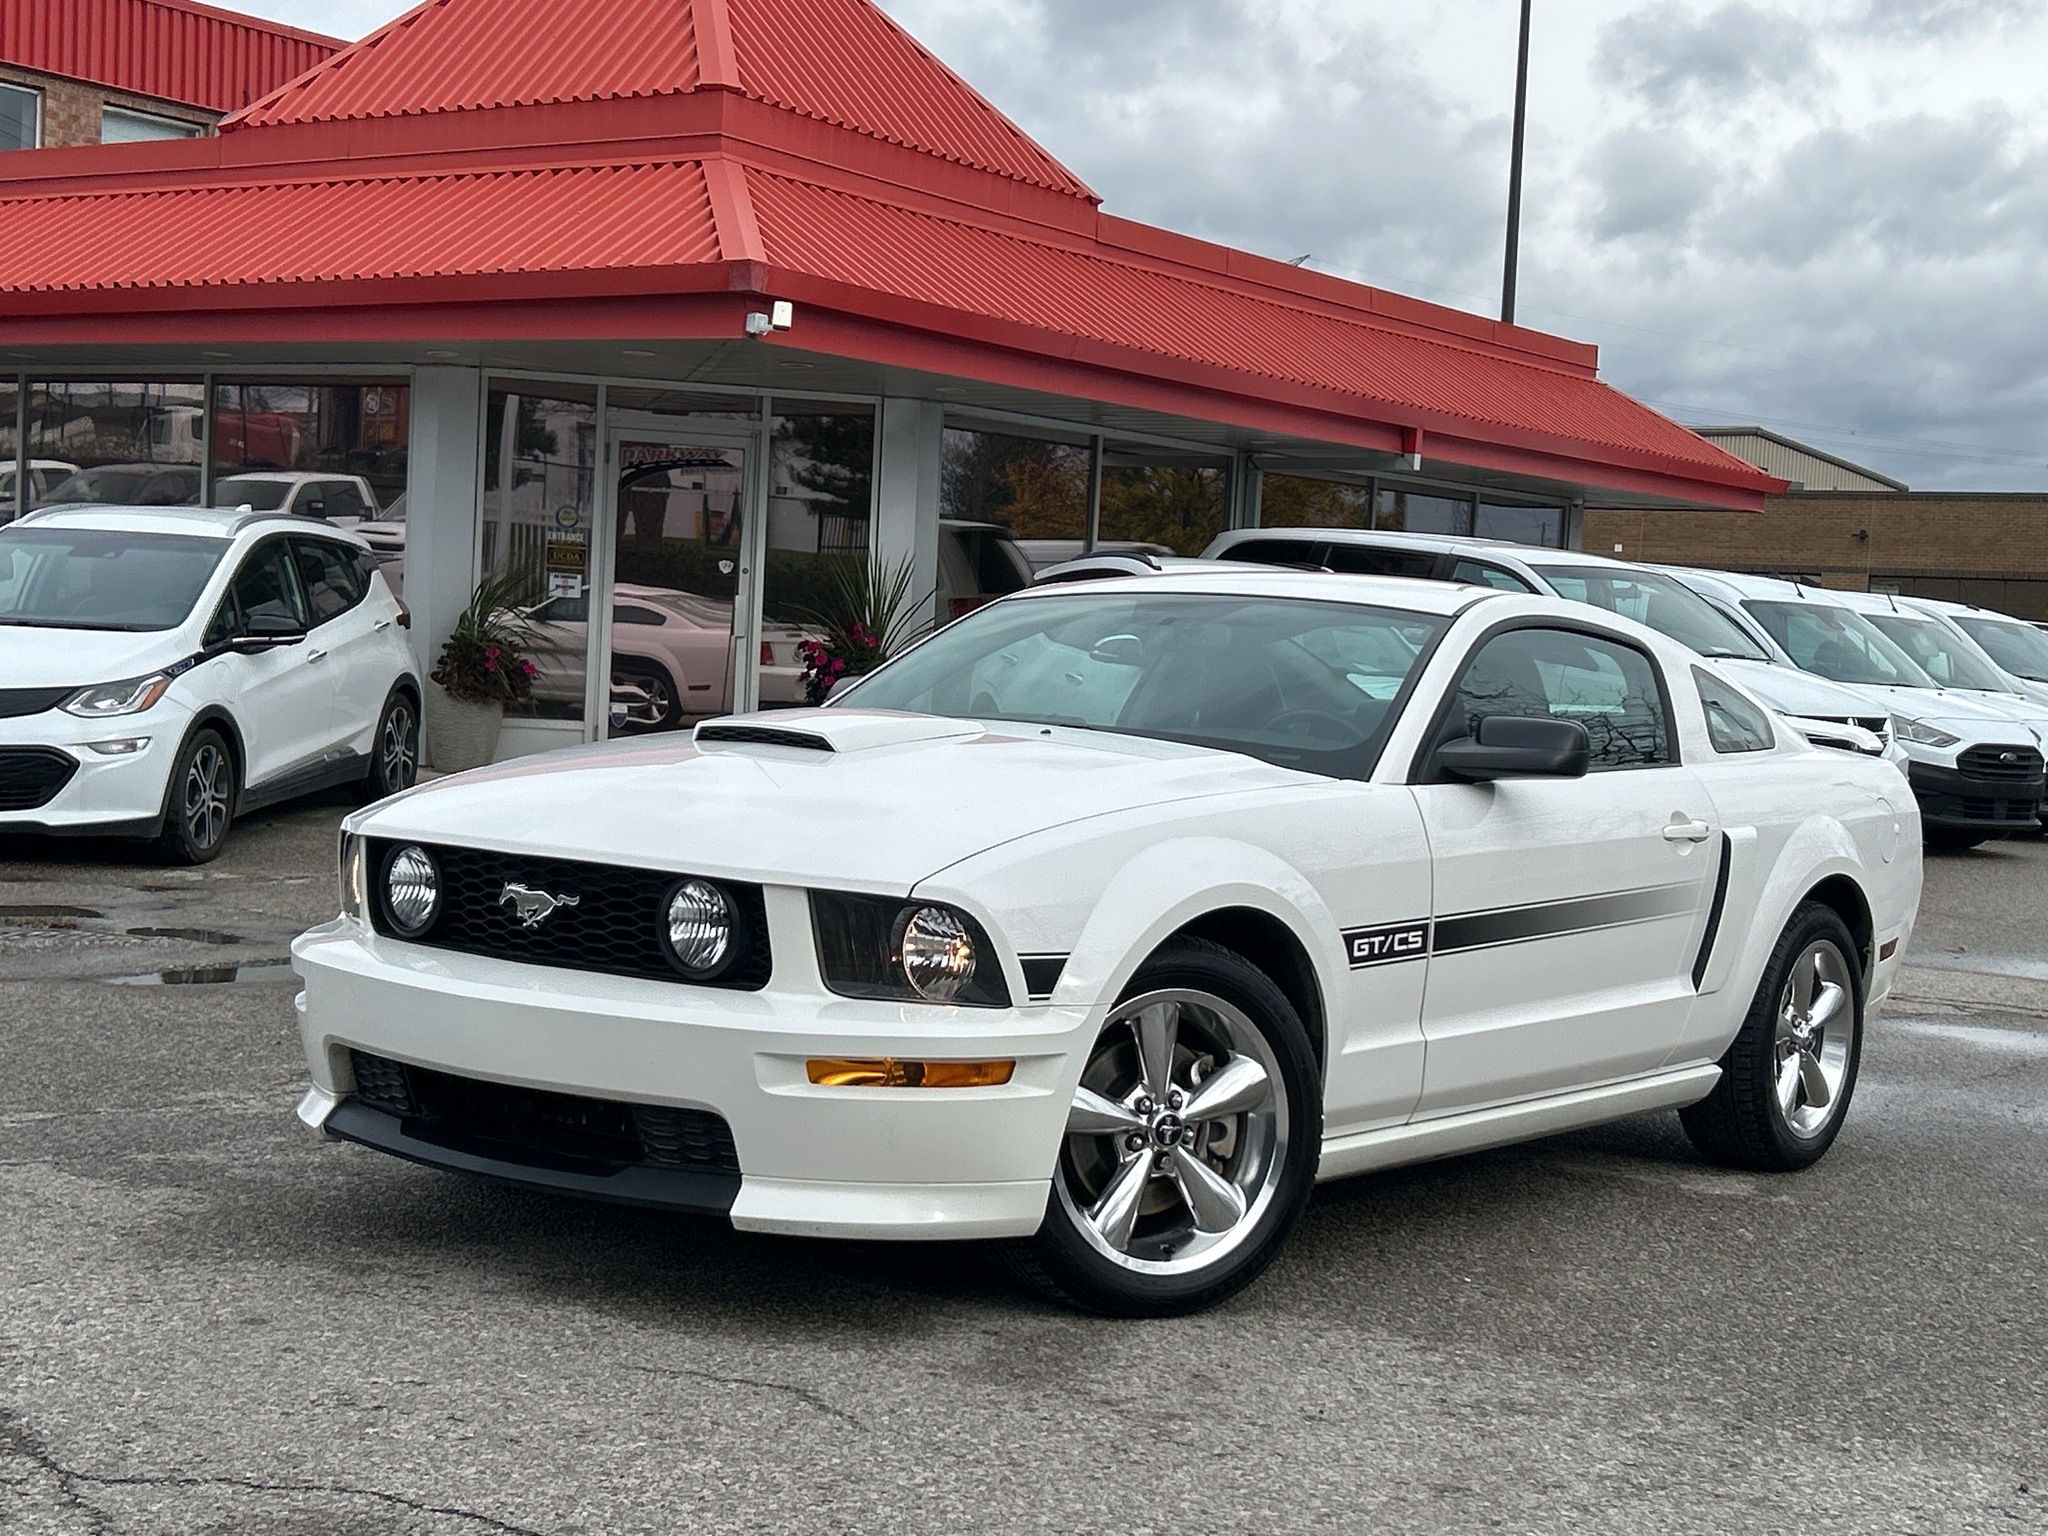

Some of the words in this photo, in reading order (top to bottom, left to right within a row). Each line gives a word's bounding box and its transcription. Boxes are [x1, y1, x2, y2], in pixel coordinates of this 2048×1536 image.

[620, 446, 727, 465] PARKWAY
[553, 551, 580, 561] UCDA
[1353, 931, 1422, 957] GT/CS
